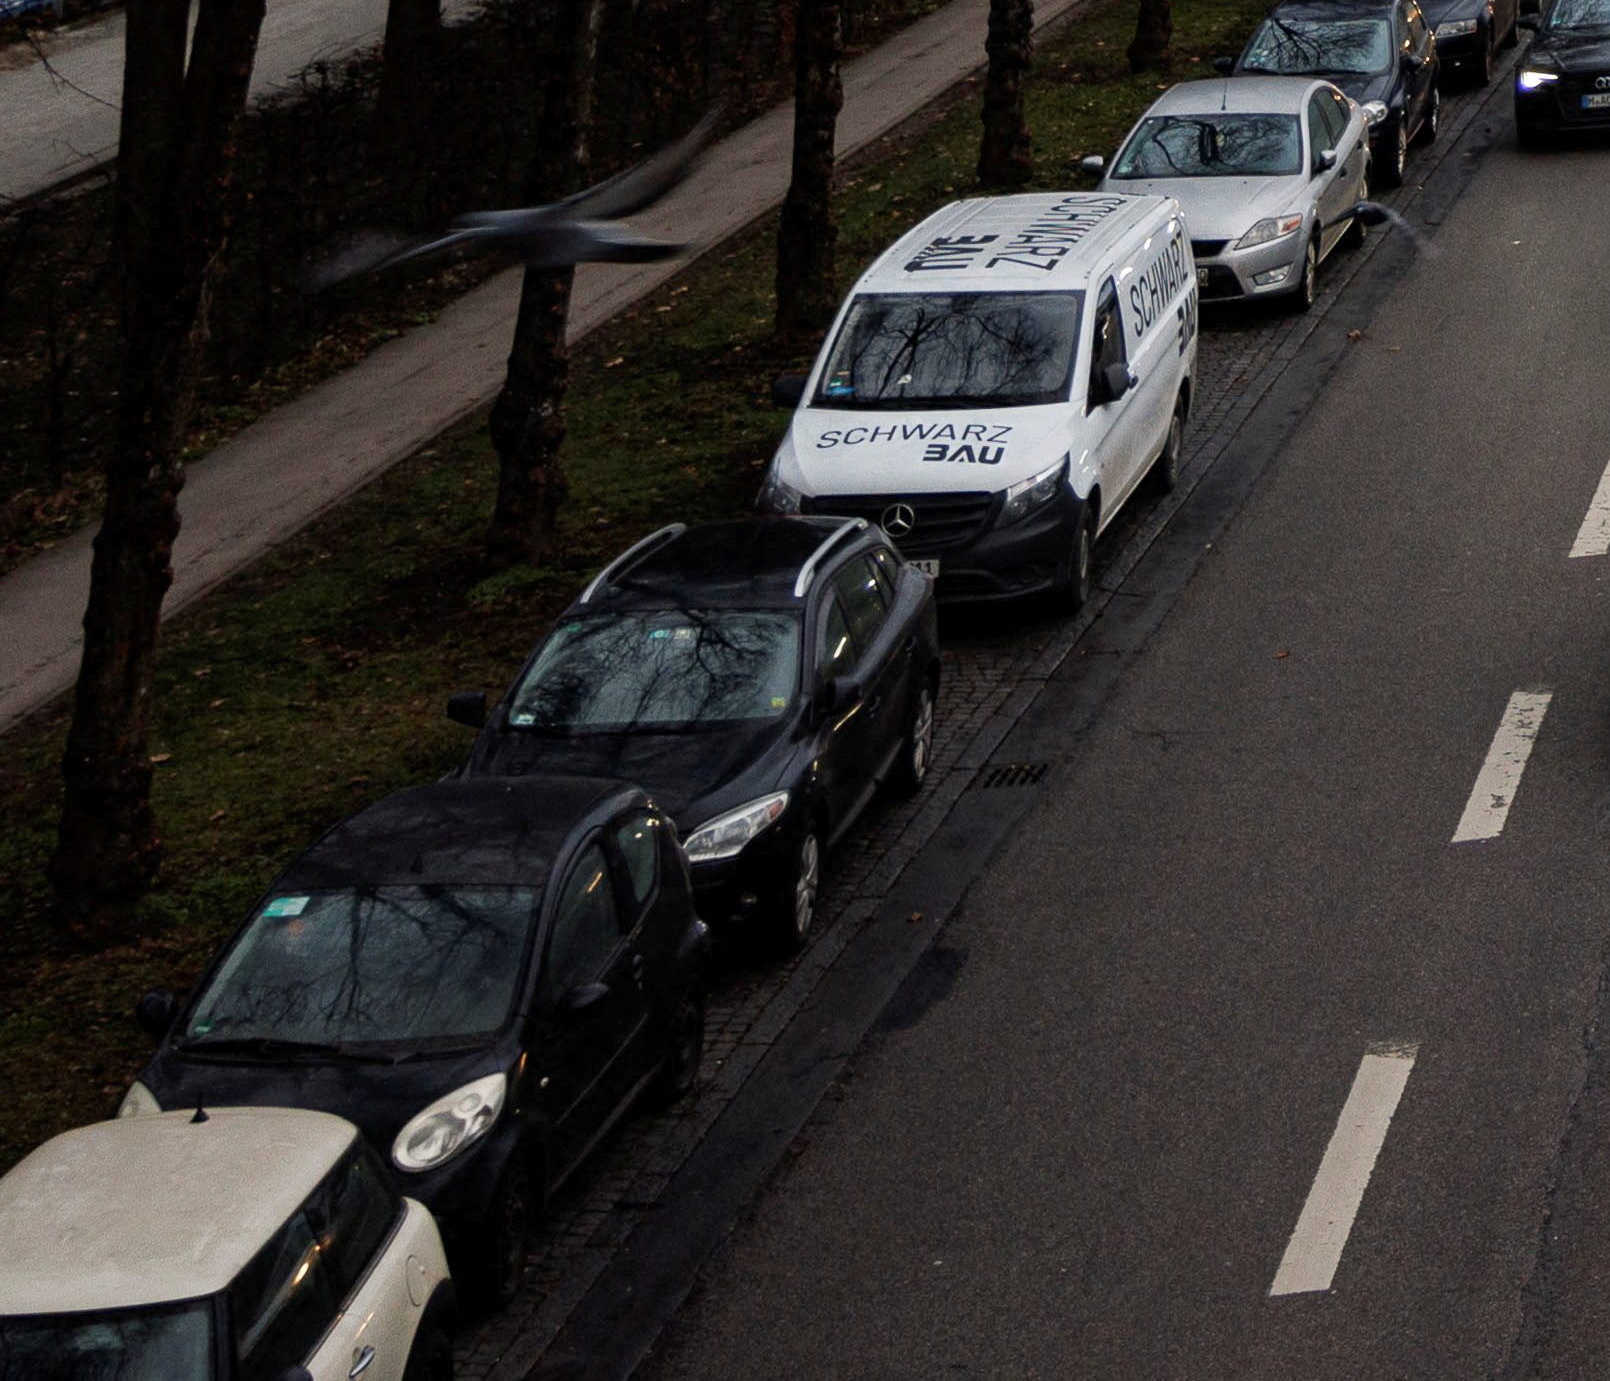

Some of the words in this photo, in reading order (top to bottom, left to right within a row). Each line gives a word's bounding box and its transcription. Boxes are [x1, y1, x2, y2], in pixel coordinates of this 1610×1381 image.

[985, 197, 1127, 271] SCHWARZ
[1130, 229, 1188, 337] SCHWARZ
[816, 423, 1013, 449] SCHWARZ
[922, 444, 1005, 465] BAU
